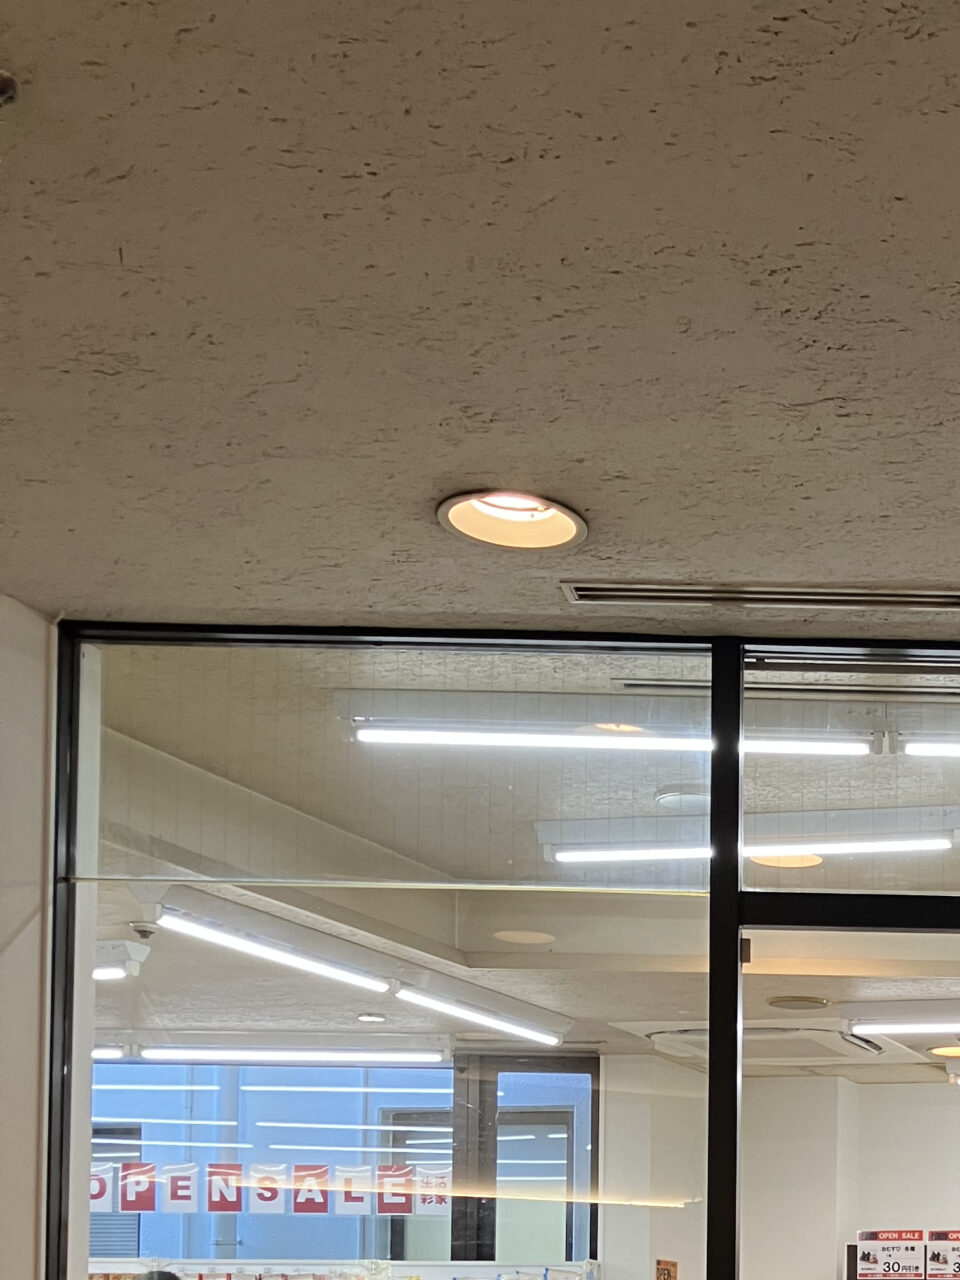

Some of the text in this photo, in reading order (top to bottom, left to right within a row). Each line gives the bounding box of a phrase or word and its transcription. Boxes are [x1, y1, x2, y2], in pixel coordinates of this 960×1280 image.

[90, 1174, 407, 1204] OPEN SALE
[879, 1232, 898, 1240] OPEN
[902, 1232, 920, 1240] SALE
